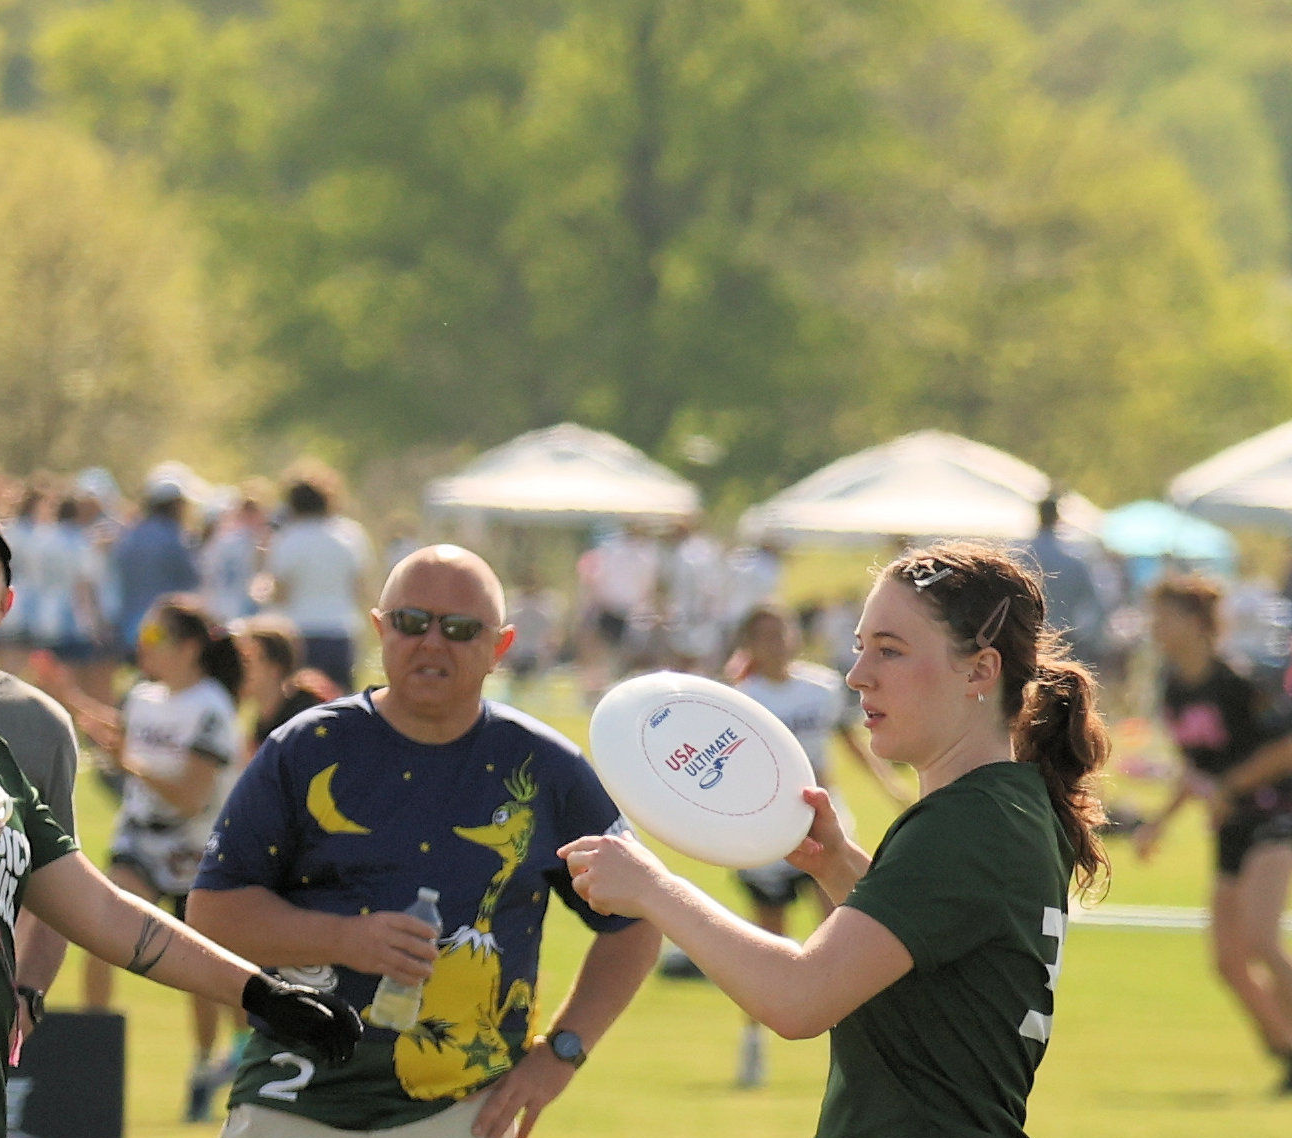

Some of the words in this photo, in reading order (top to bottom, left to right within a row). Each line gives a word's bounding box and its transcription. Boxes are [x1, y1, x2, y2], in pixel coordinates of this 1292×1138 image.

[665, 742, 698, 771] USA
[684, 727, 738, 777] ULTIMATE
[258, 1051, 316, 1101] 2
